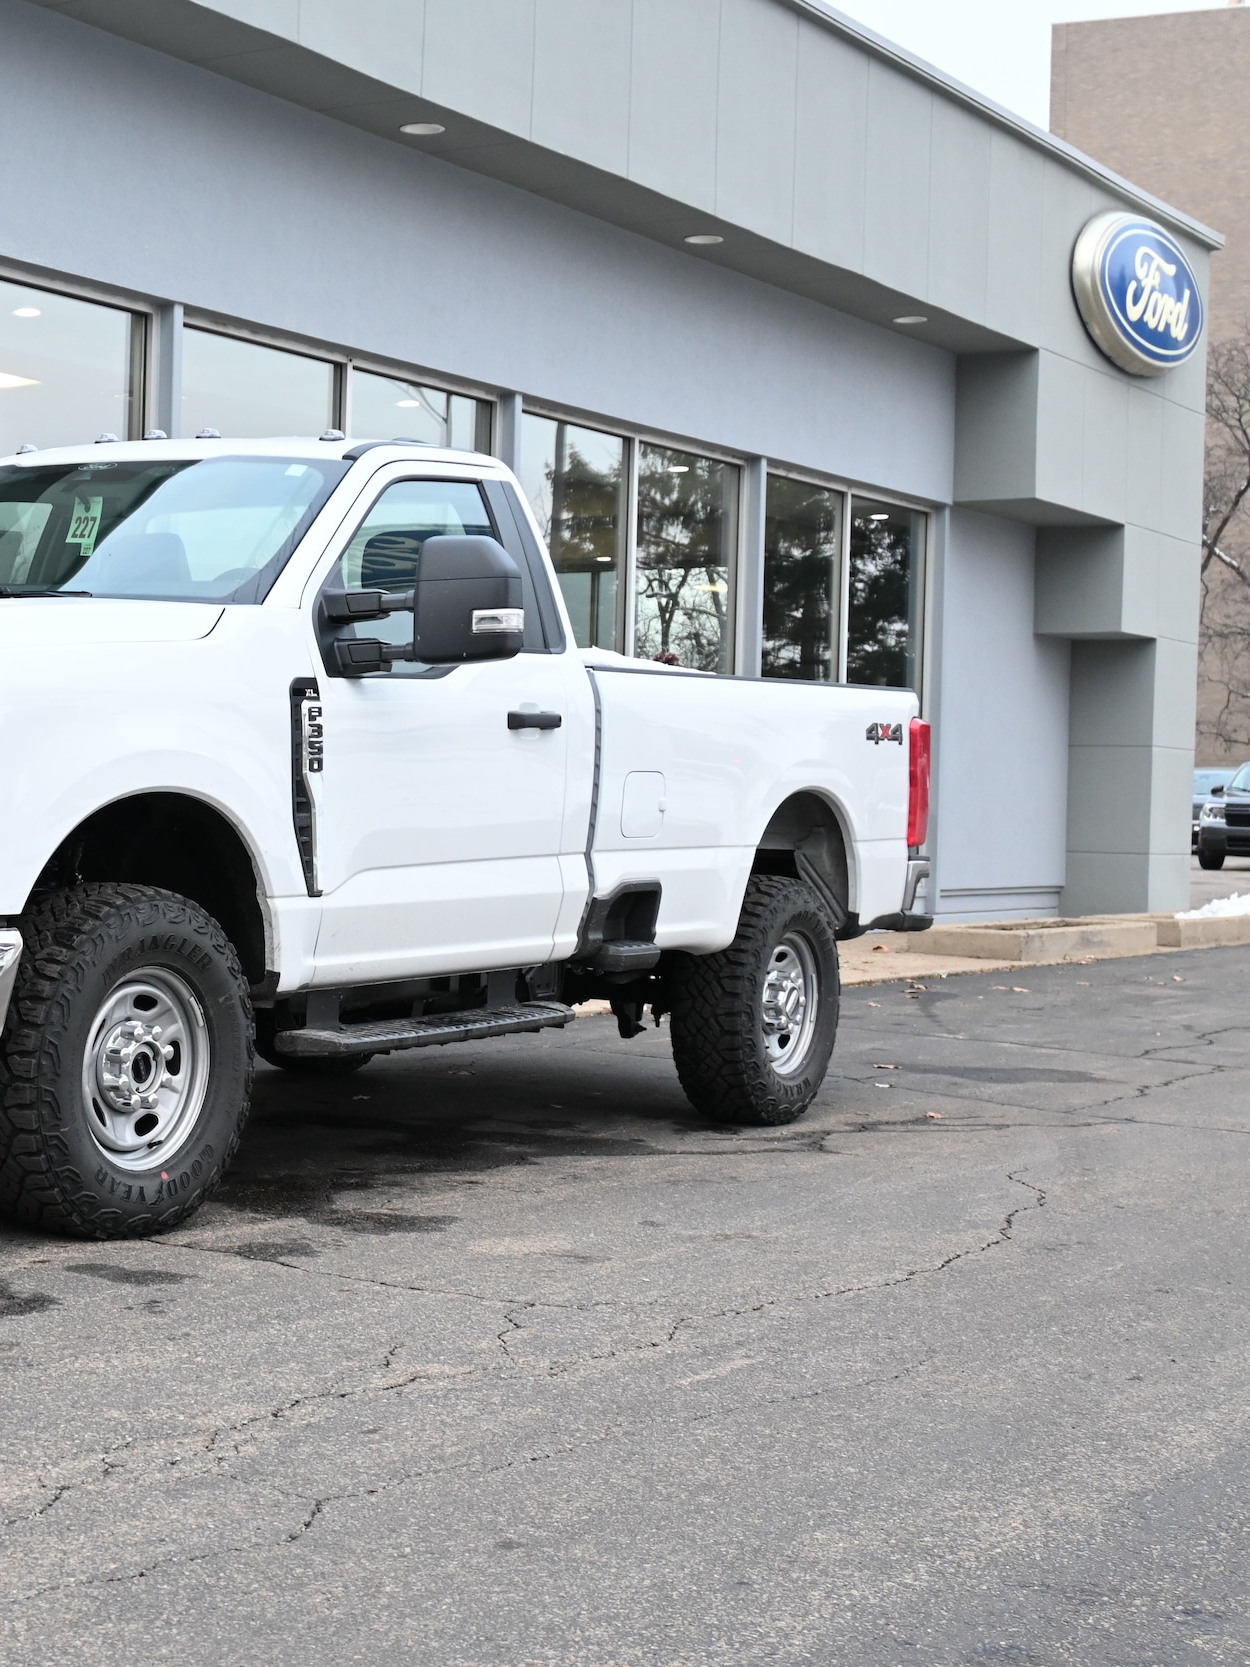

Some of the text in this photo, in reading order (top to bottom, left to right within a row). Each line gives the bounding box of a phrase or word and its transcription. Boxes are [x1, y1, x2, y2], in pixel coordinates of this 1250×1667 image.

[1125, 245, 1191, 342] Ford
[70, 516, 98, 539] 227
[304, 688, 318, 697] XL
